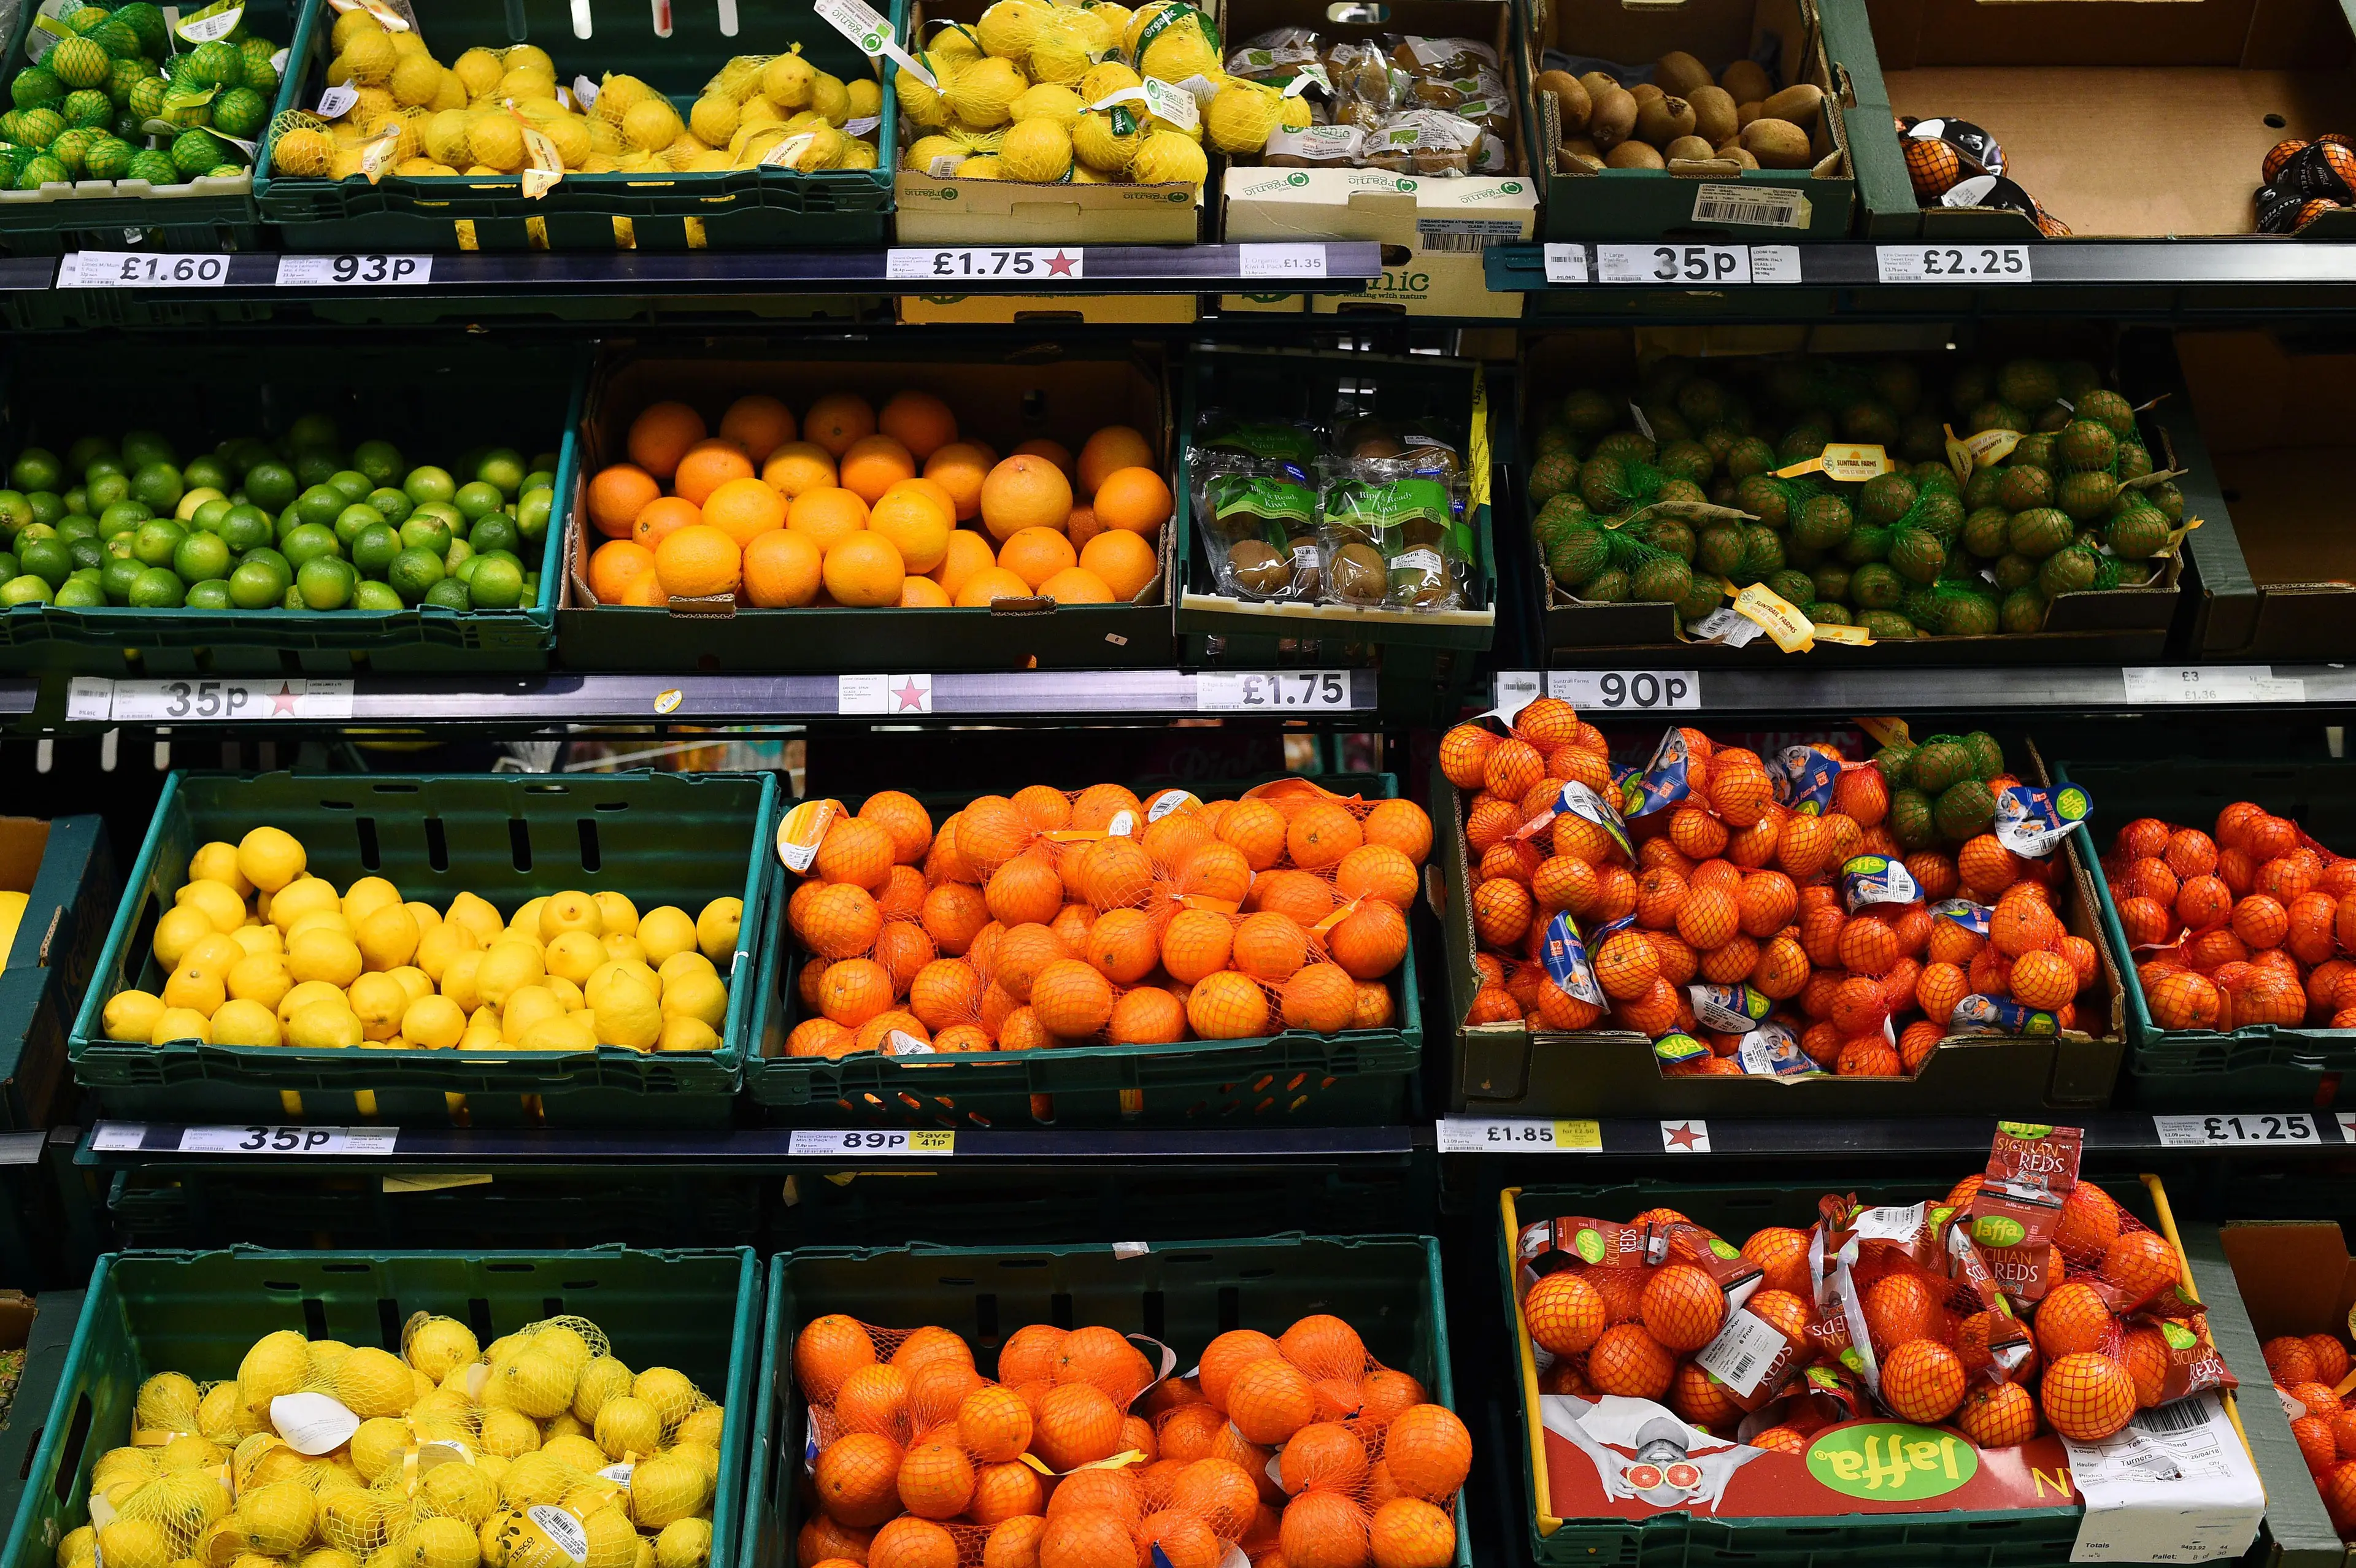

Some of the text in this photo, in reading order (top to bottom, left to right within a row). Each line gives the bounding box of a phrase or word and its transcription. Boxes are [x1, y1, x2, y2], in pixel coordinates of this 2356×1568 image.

[832, 9, 883, 52] Organic
[1144, 9, 1177, 38] Organic
[1146, 80, 1184, 106] Organic
[773, 141, 798, 164] SUNTRAIL
[905, 187, 958, 201] Organic
[1244, 172, 1309, 196] Organic
[1348, 174, 1418, 193] Organic
[1460, 182, 1523, 204] Organic
[1123, 192, 1188, 203] Organic
[120, 256, 221, 281] £1.60
[332, 255, 415, 282] 93p
[933, 252, 1034, 275] £1.75
[1284, 258, 1322, 268] £1.35
[1653, 247, 1737, 280] 35p
[1923, 250, 2023, 274] £2.25
[1250, 484, 1266, 496] Ripe
[1274, 493, 1299, 502] Ready
[1260, 479, 1282, 492] TESCO
[1360, 491, 1379, 501] Ripe
[1388, 491, 1412, 503] Ready
[1265, 498, 1288, 508] Kiwi
[1377, 502, 1397, 513] Kiwi
[1754, 599, 1780, 620] SUNTRAIL
[1779, 615, 1798, 635] FARMS
[2182, 671, 2200, 682] £3
[166, 682, 248, 717] 35p
[1242, 674, 1344, 705] £1.75
[1600, 672, 1688, 707] 90p
[2185, 690, 2217, 700] £1.36
[239, 1126, 331, 1151] 35p
[1487, 1126, 1553, 1142] £1.85
[2203, 1116, 2311, 1140] £1.25
[842, 1132, 905, 1148] 89p
[1996, 1138, 2059, 1158] SICILIAN
[2019, 1151, 2065, 1174] REDS
[2005, 1202, 2031, 1211] jaffa.co.uk
[1619, 1228, 1637, 1253] REDS
[1975, 1219, 2021, 1242] Jaffa
[1577, 1231, 1596, 1262] Jaffa
[1606, 1229, 1620, 1266] SICILIAN
[1994, 1262, 2039, 1283] REDS
[1712, 1338, 1723, 1351] Before
[1723, 1318, 1740, 1337] 30-Apr
[1743, 1324, 1755, 1340] Fruit
[1709, 1351, 1719, 1363] Origin:
[1760, 1346, 1793, 1387] REDS
[2173, 1347, 2214, 1366] SICILIAN
[2189, 1358, 2224, 1381] REDS
[2127, 1437, 2150, 1449] Tesco
[2189, 1448, 2220, 1461] 26/04/18
[1827, 1433, 1960, 1490] Jaffa
[2120, 1453, 2153, 1466] Turners
[533, 1510, 545, 1522] FRUITS
[509, 1536, 534, 1559] TESCO
[523, 1543, 546, 1568] nwaxed
